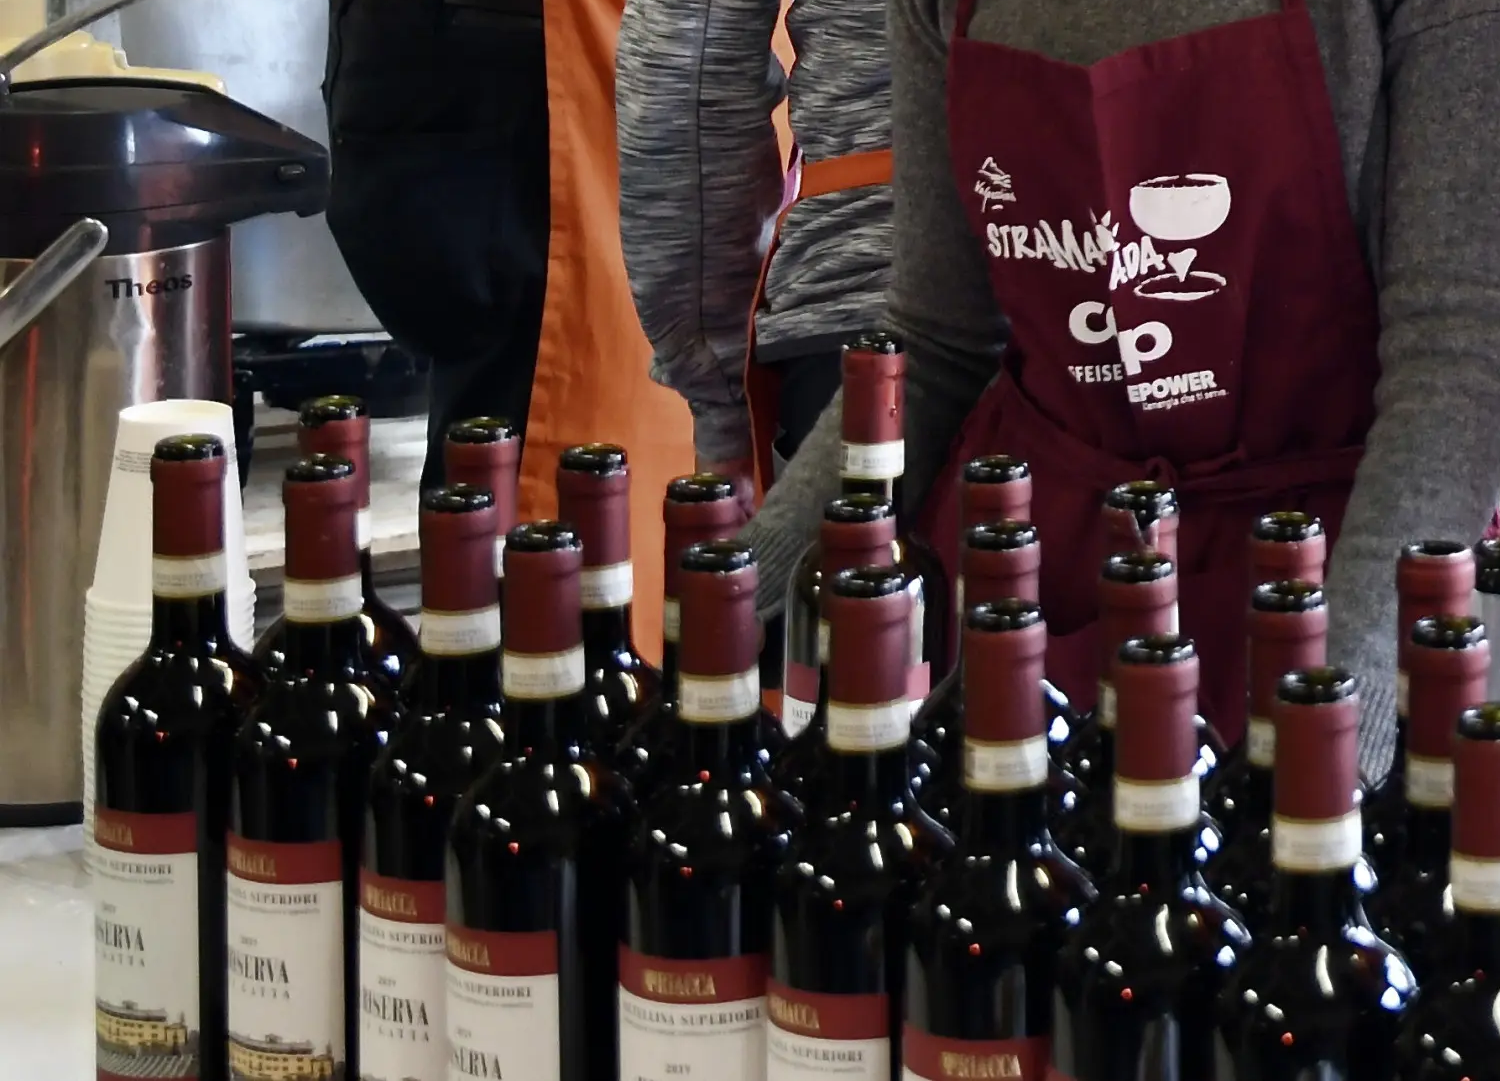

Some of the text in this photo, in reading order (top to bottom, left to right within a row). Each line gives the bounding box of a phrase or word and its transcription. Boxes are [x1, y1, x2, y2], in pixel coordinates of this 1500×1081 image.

[104, 274, 193, 299] Theos
[1126, 370, 1218, 403] EPOWER
[388, 929, 443, 946] SUPERIO
